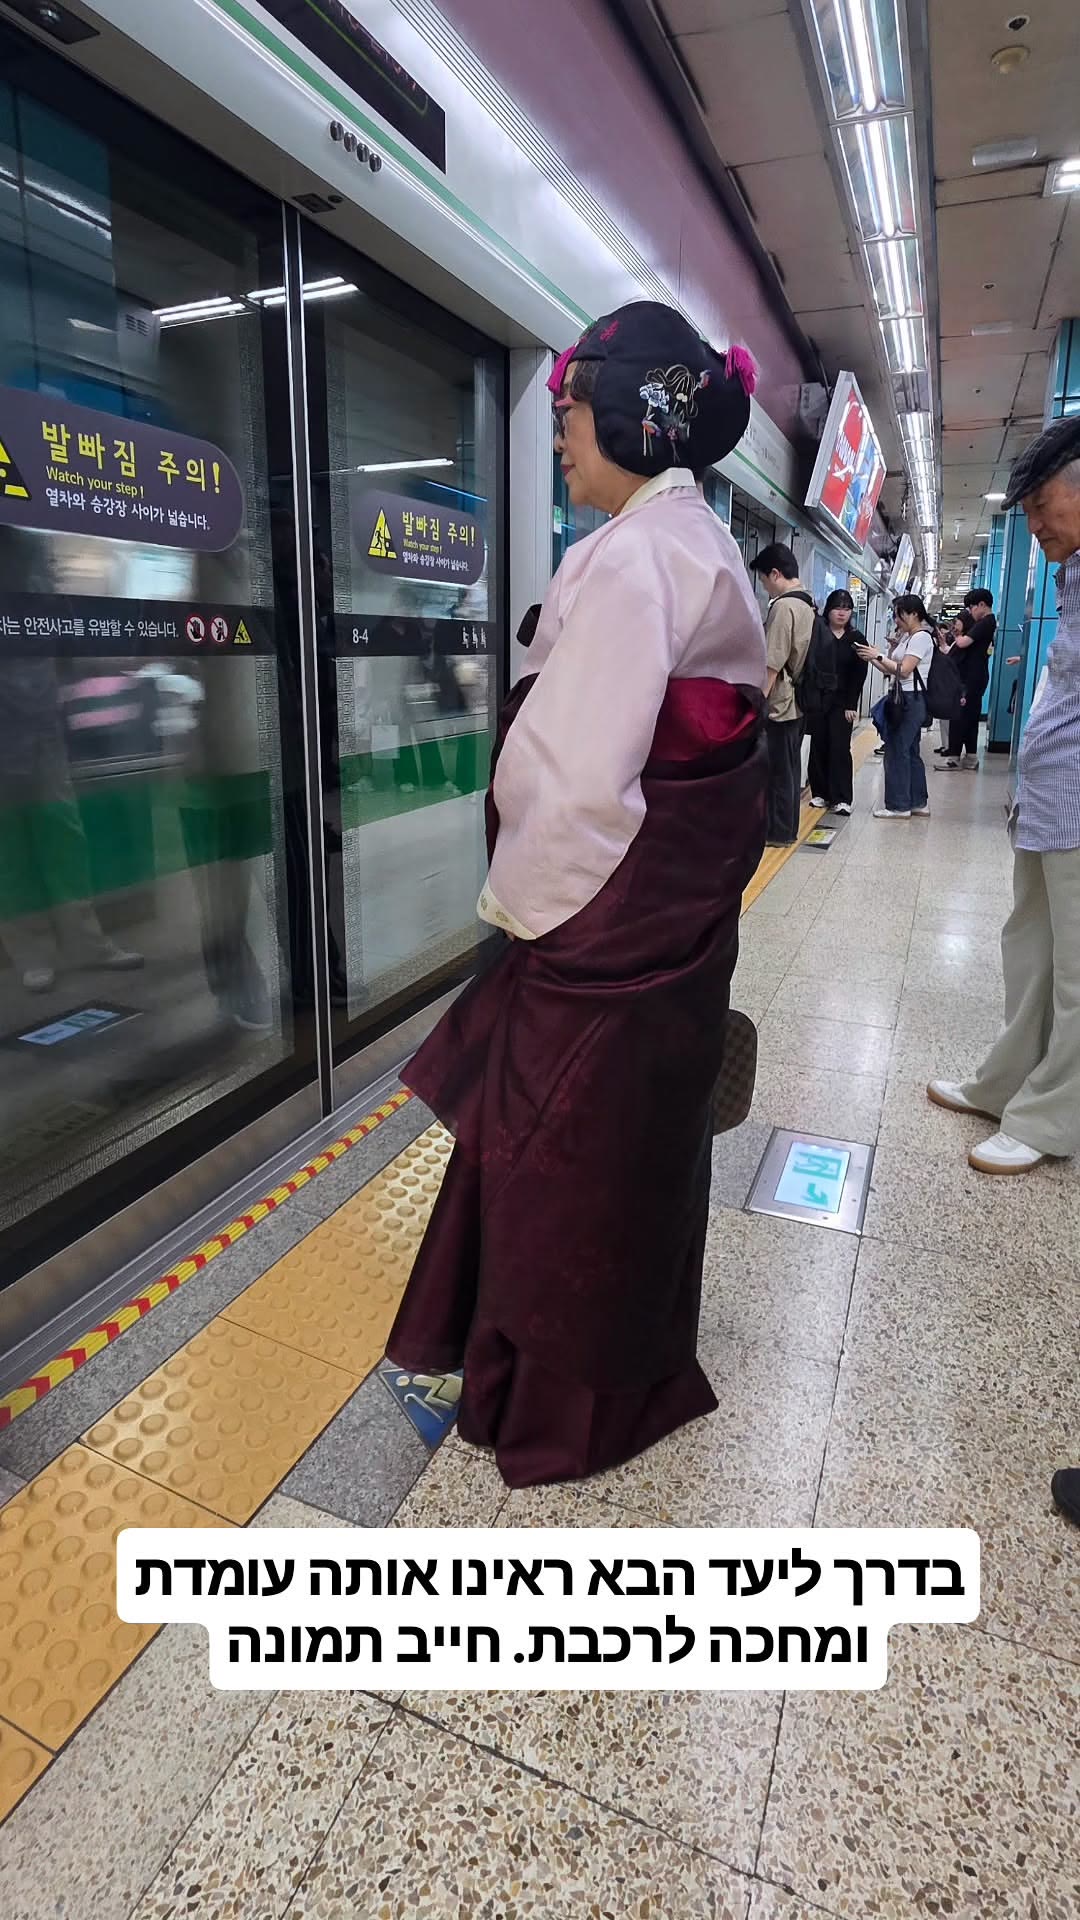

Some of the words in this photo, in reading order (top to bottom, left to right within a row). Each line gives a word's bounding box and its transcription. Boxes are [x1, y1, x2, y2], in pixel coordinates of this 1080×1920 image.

[42, 421, 136, 478] 발빠짐
[158, 451, 220, 493] 주의!
[46, 465, 84, 486] Watch
[87, 476, 112, 491] your
[46, 487, 86, 510] 열차와
[90, 495, 127, 517] 승강장
[131, 503, 164, 523] 사이가
[402, 511, 440, 541] 발빠짐
[448, 522, 475, 547] 주의!
[24, 616, 85, 636] 안전사고를
[88, 619, 121, 637] 유발할
[124, 621, 135, 637] 수
[138, 621, 179, 638] 있습니다.
[352, 628, 368, 643] 8-4
